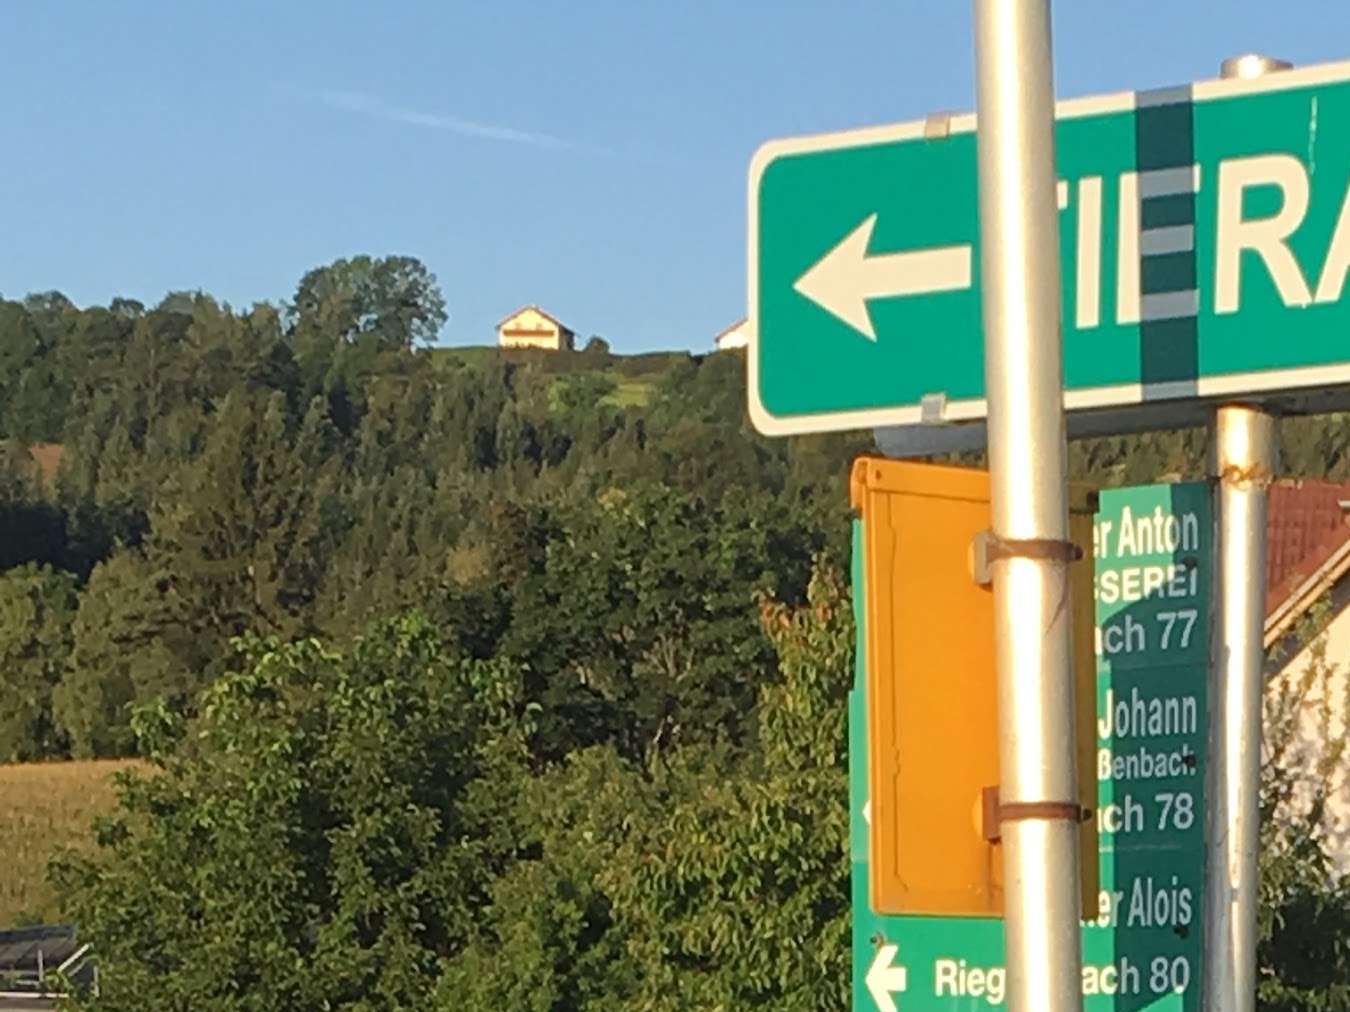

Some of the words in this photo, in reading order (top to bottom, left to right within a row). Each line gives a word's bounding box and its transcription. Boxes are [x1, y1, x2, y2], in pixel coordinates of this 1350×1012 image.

[1116, 505, 1198, 558] Anton
[1094, 563, 1198, 604] SEREI
[1156, 609, 1198, 650] 77
[1098, 687, 1197, 739] Johann
[1154, 793, 1194, 831] 78
[1127, 876, 1192, 928] Alois
[1150, 956, 1190, 995] 80
